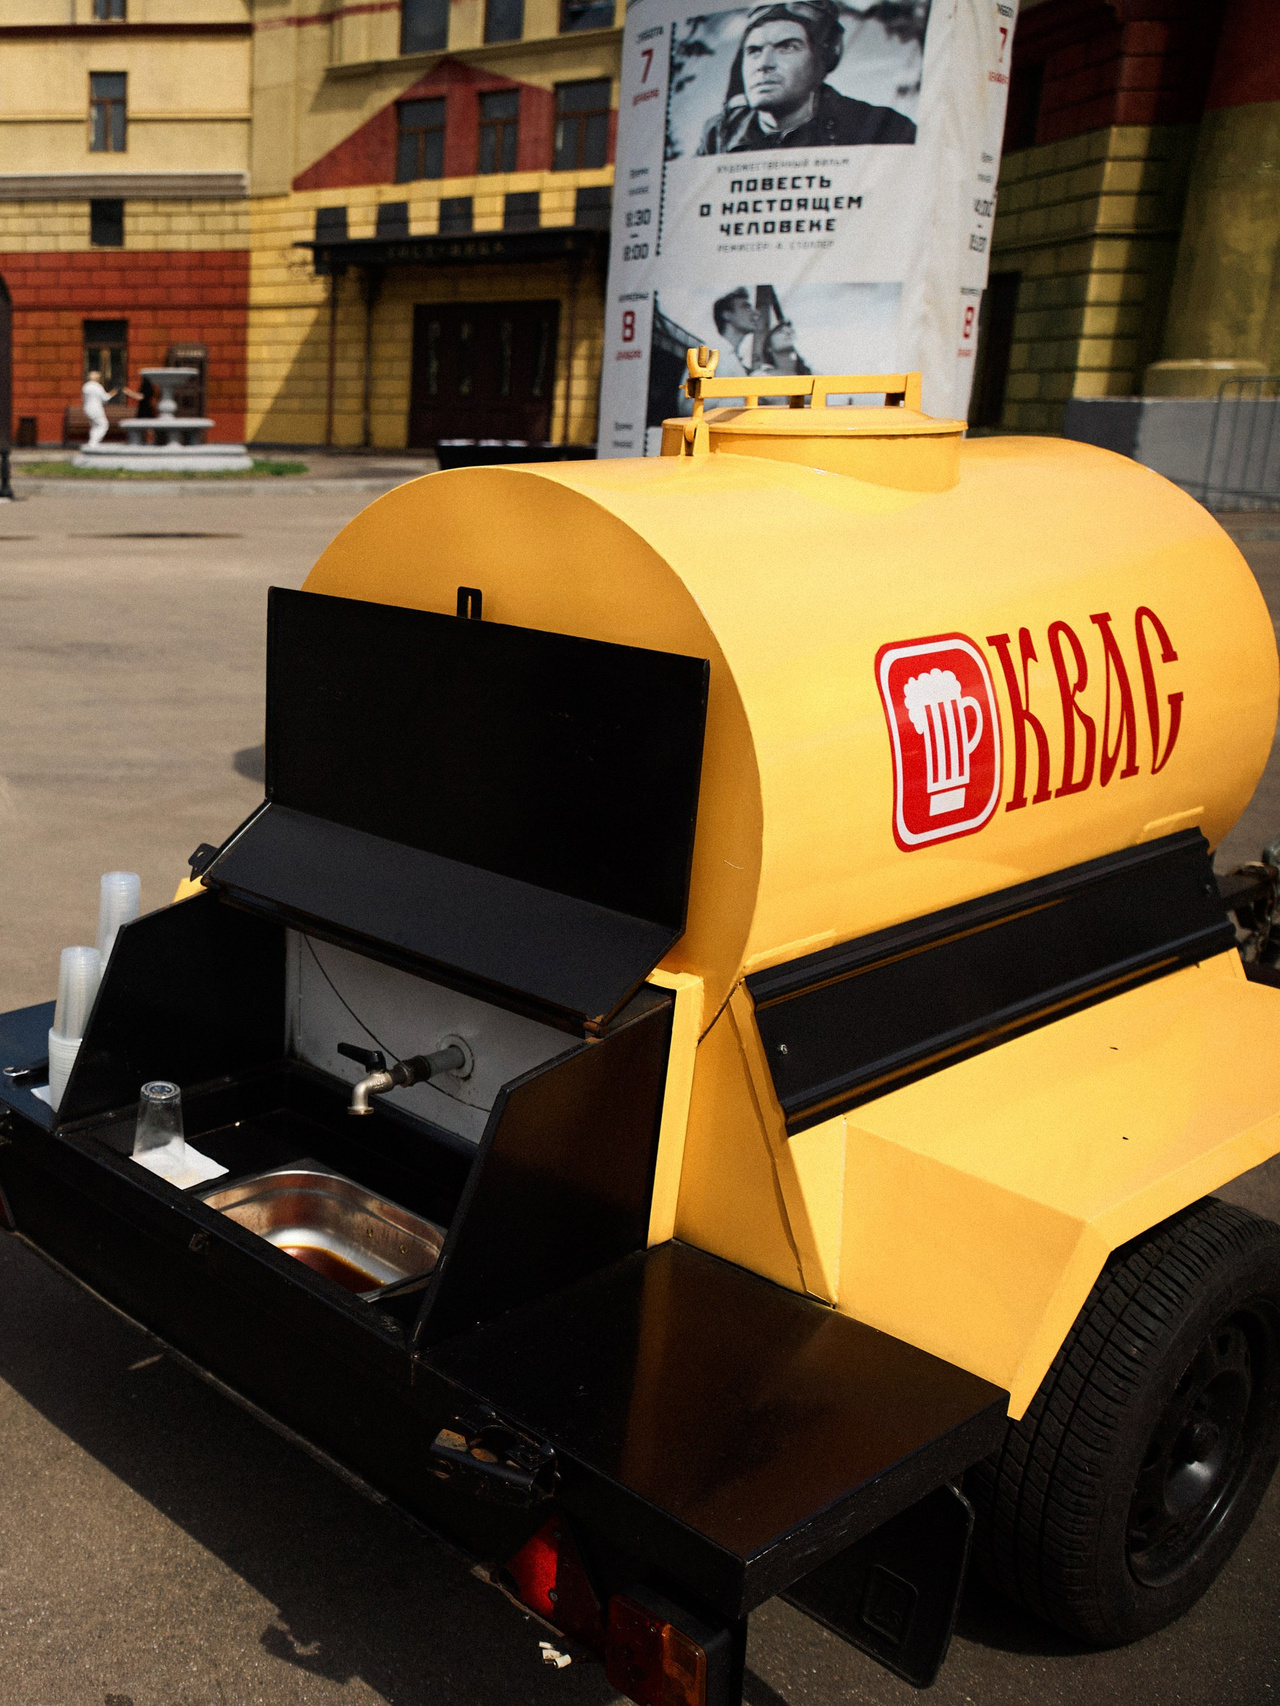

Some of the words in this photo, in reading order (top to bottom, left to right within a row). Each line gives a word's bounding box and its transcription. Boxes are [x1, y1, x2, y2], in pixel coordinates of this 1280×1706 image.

[641, 47, 653, 84] 7
[730, 175, 832, 194] ПОВЕСТЬ
[699, 203, 712, 217] О
[722, 196, 863, 216] НАСТОЯЩЕМ
[720, 218, 836, 236] ЧЕЛОВЕКЕ
[622, 309, 635, 342] 8
[986, 606, 1184, 813] КВАС
